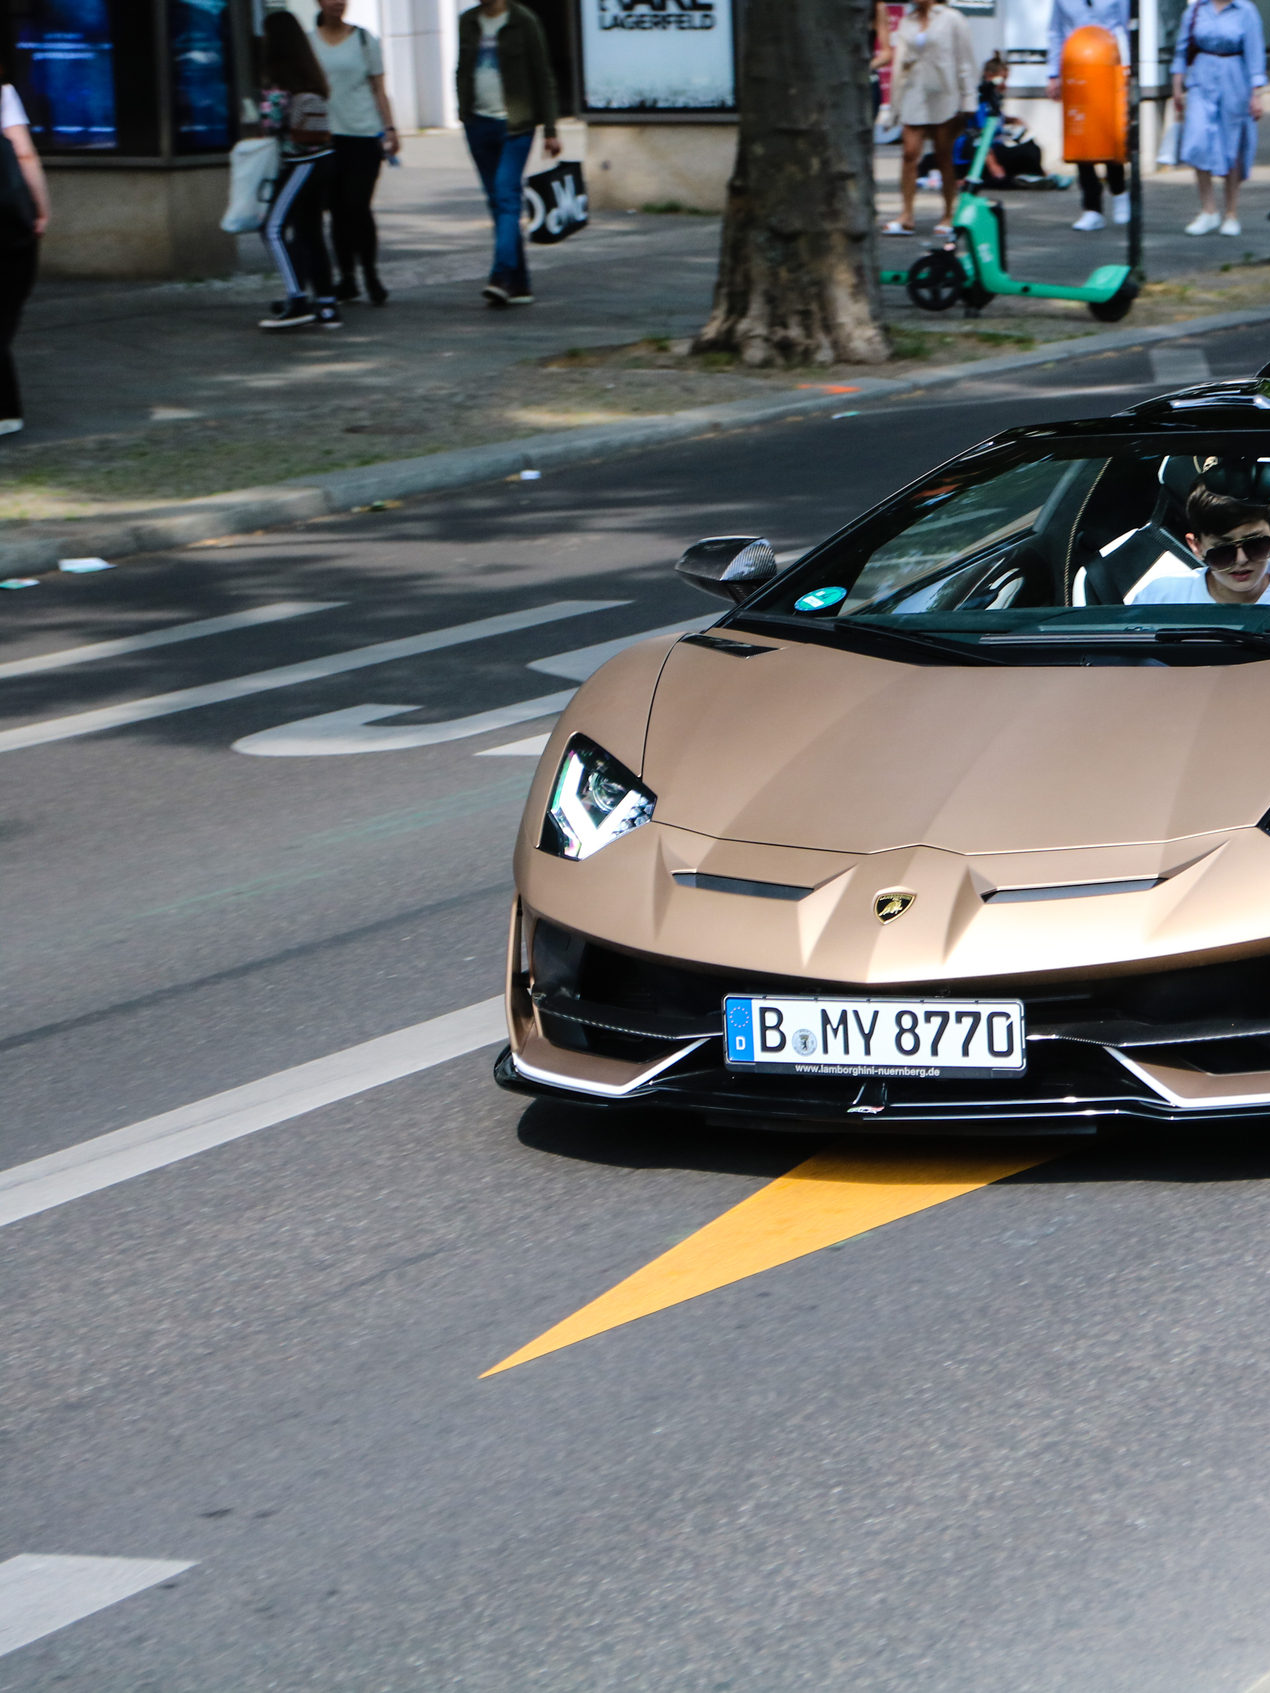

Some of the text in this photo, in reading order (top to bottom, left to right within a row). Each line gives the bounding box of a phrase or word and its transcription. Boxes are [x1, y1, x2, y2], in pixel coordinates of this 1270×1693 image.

[599, 13, 715, 30] LAGERFELD
[758, 1006, 787, 1053] B
[820, 1008, 880, 1057] MY
[894, 1010, 1015, 1058] 8770
[735, 1036, 746, 1051] D
[795, 1063, 940, 1077] www.lamborghini-nuernberg.de
